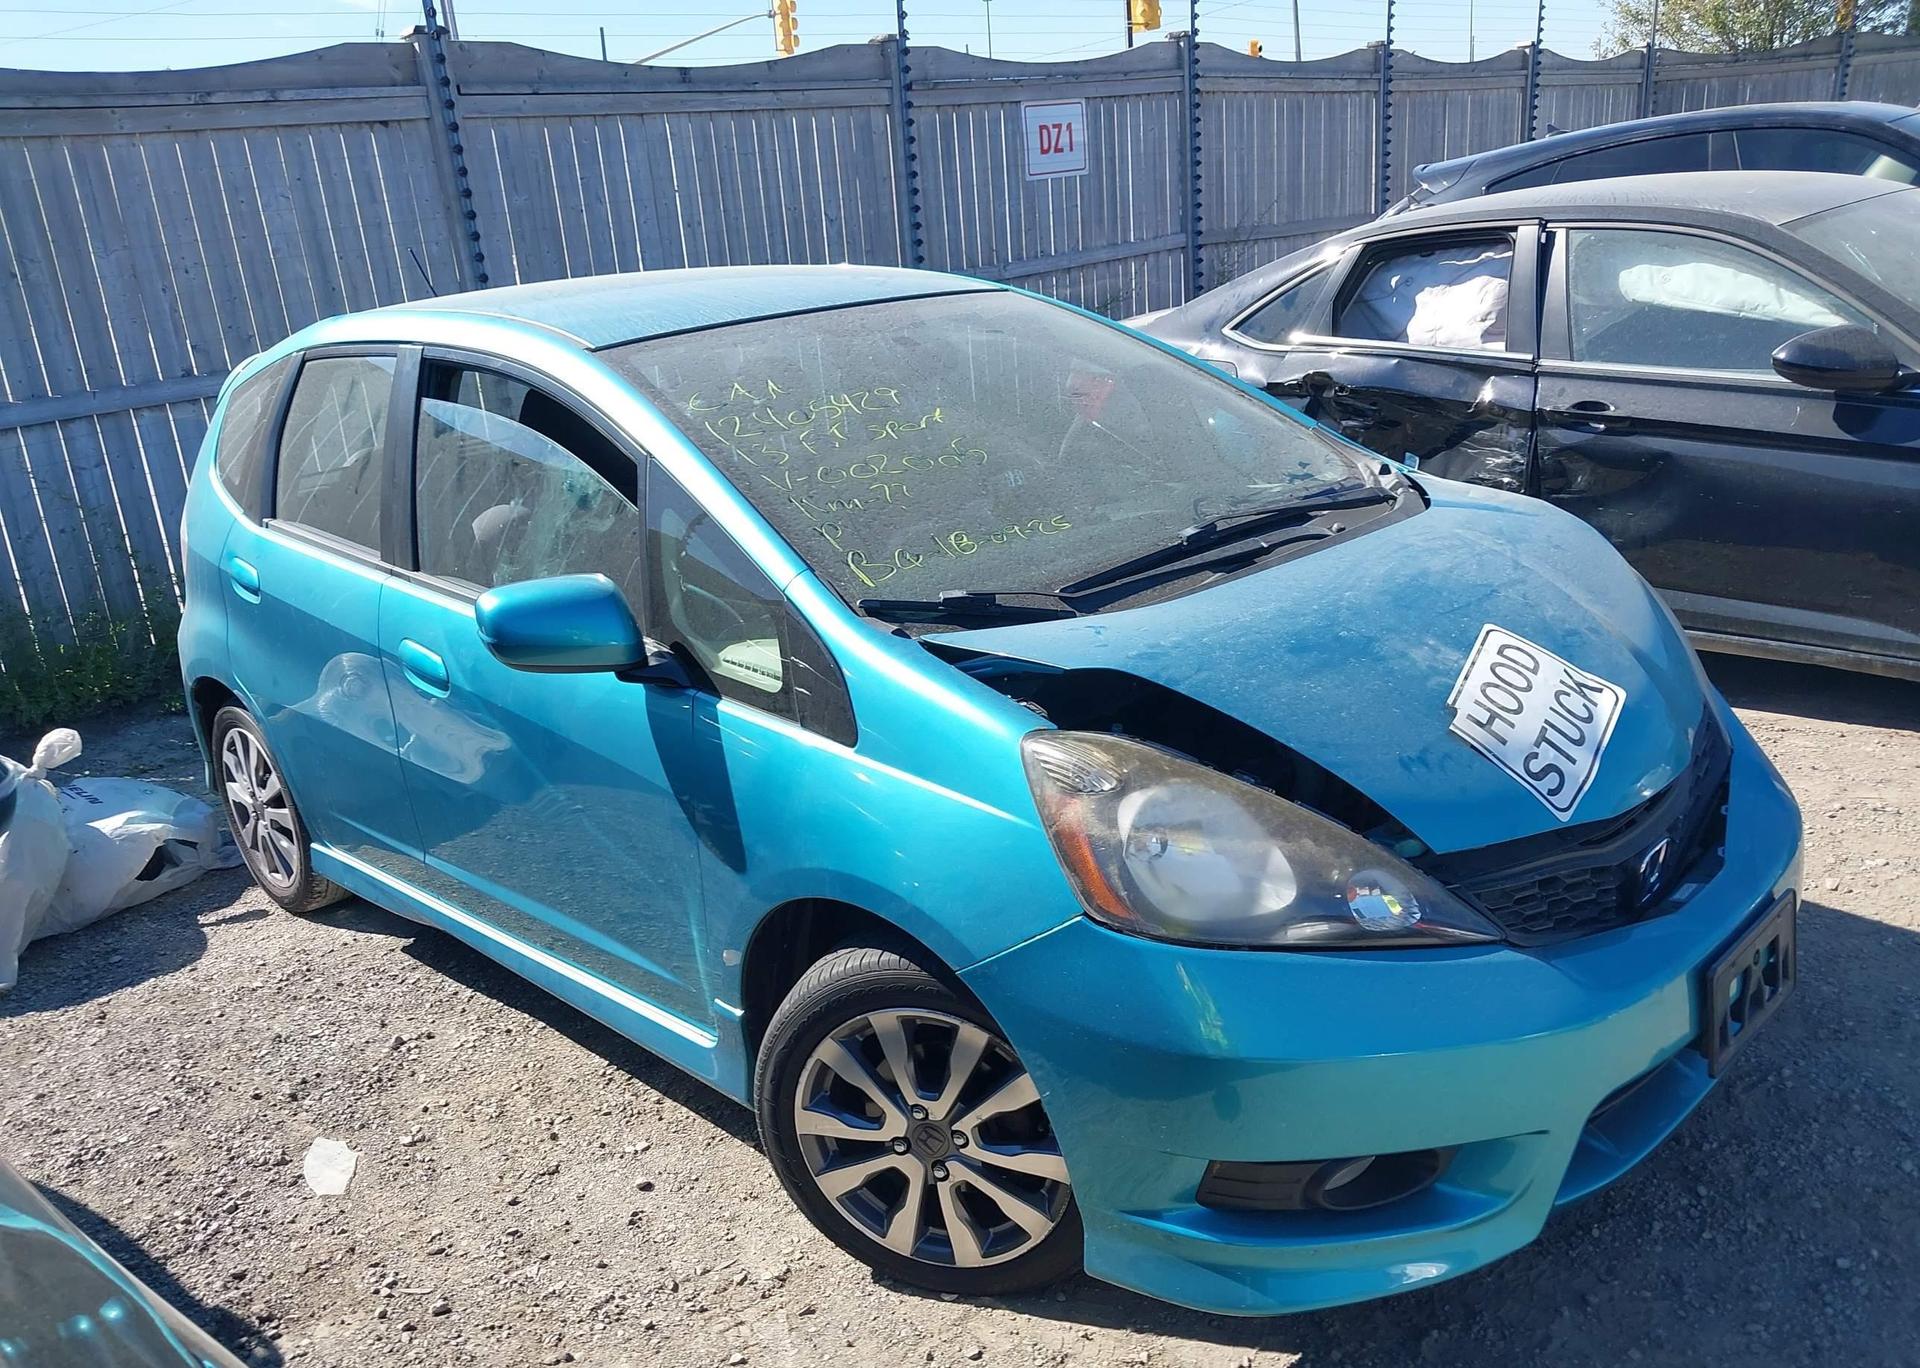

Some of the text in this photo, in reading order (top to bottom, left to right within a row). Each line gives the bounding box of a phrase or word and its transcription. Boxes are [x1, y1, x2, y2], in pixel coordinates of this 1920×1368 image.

[1039, 122, 1073, 155] DZ1
[705, 387, 901, 446] 12405429
[1466, 644, 1540, 746] HOOD
[1523, 669, 1604, 797] STUCK
